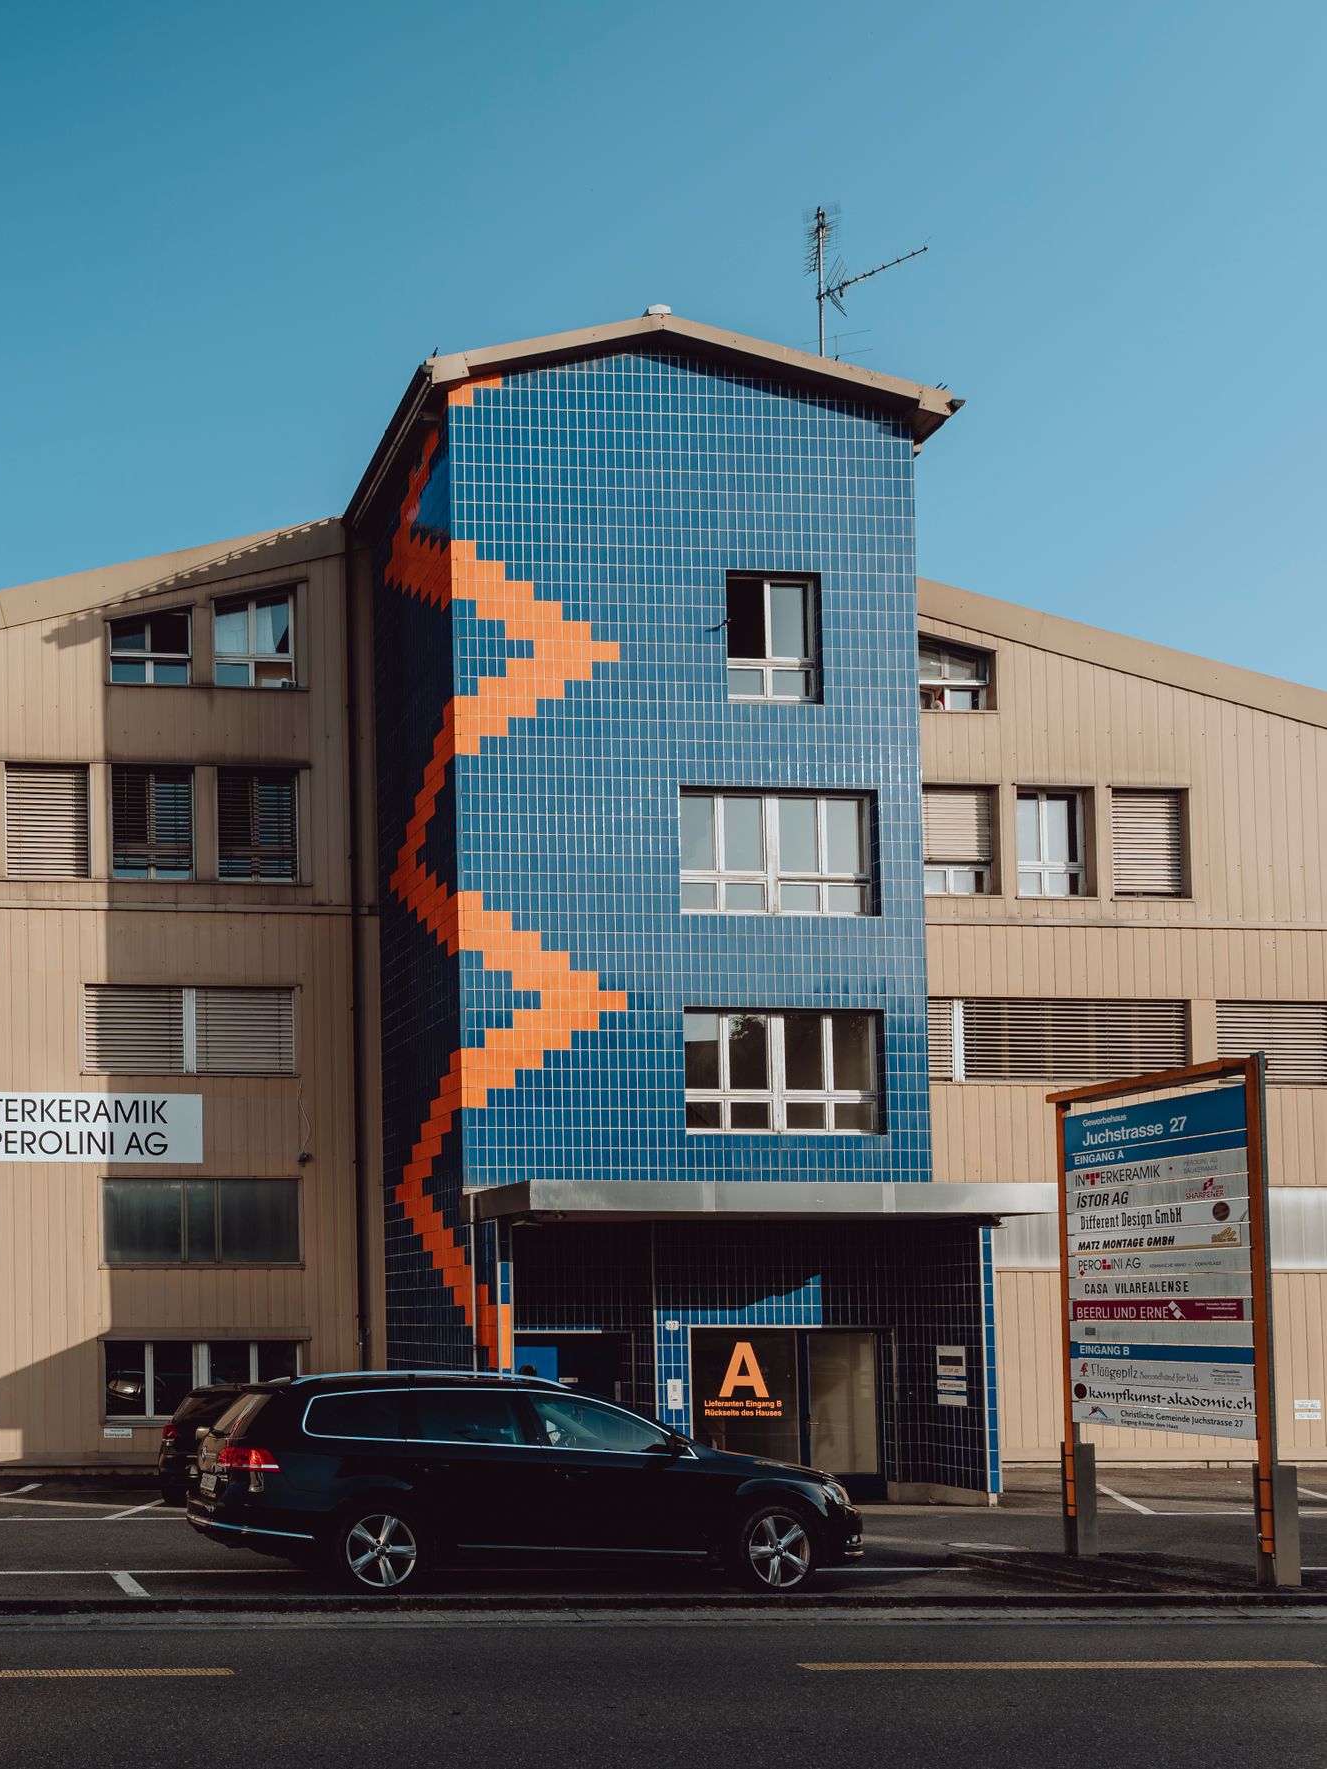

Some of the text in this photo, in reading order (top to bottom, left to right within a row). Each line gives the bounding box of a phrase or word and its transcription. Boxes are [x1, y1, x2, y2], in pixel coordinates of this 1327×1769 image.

[1082, 1114, 1127, 1127] Gewerbehaus
[1082, 1116, 1188, 1147] Juchstrasse 27
[124, 1131, 168, 1156] AG
[1074, 1150, 1124, 1166] EINGANG A
[1112, 1191, 1129, 1206] AG
[1080, 1207, 1183, 1230] Different Design GmbH
[1078, 1235, 1175, 1251] MATZ MONTAGE GMBH
[1125, 1257, 1141, 1269] AG
[1084, 1280, 1190, 1295] CASA VILAREALENSE
[1077, 1306, 1169, 1319] BEERLI UND ERNE
[1079, 1345, 1130, 1356] EINGANG B
[718, 1341, 770, 1397] A
[746, 1400, 775, 1409] Eingang
[1089, 1386, 1253, 1410] kampfkunst-akademie.ch
[1120, 1410, 1154, 1421] Christliche
[1156, 1412, 1190, 1424] Gemeinde
[1192, 1415, 1233, 1428] Juchstrasse
[1234, 1419, 1244, 1428] 27
